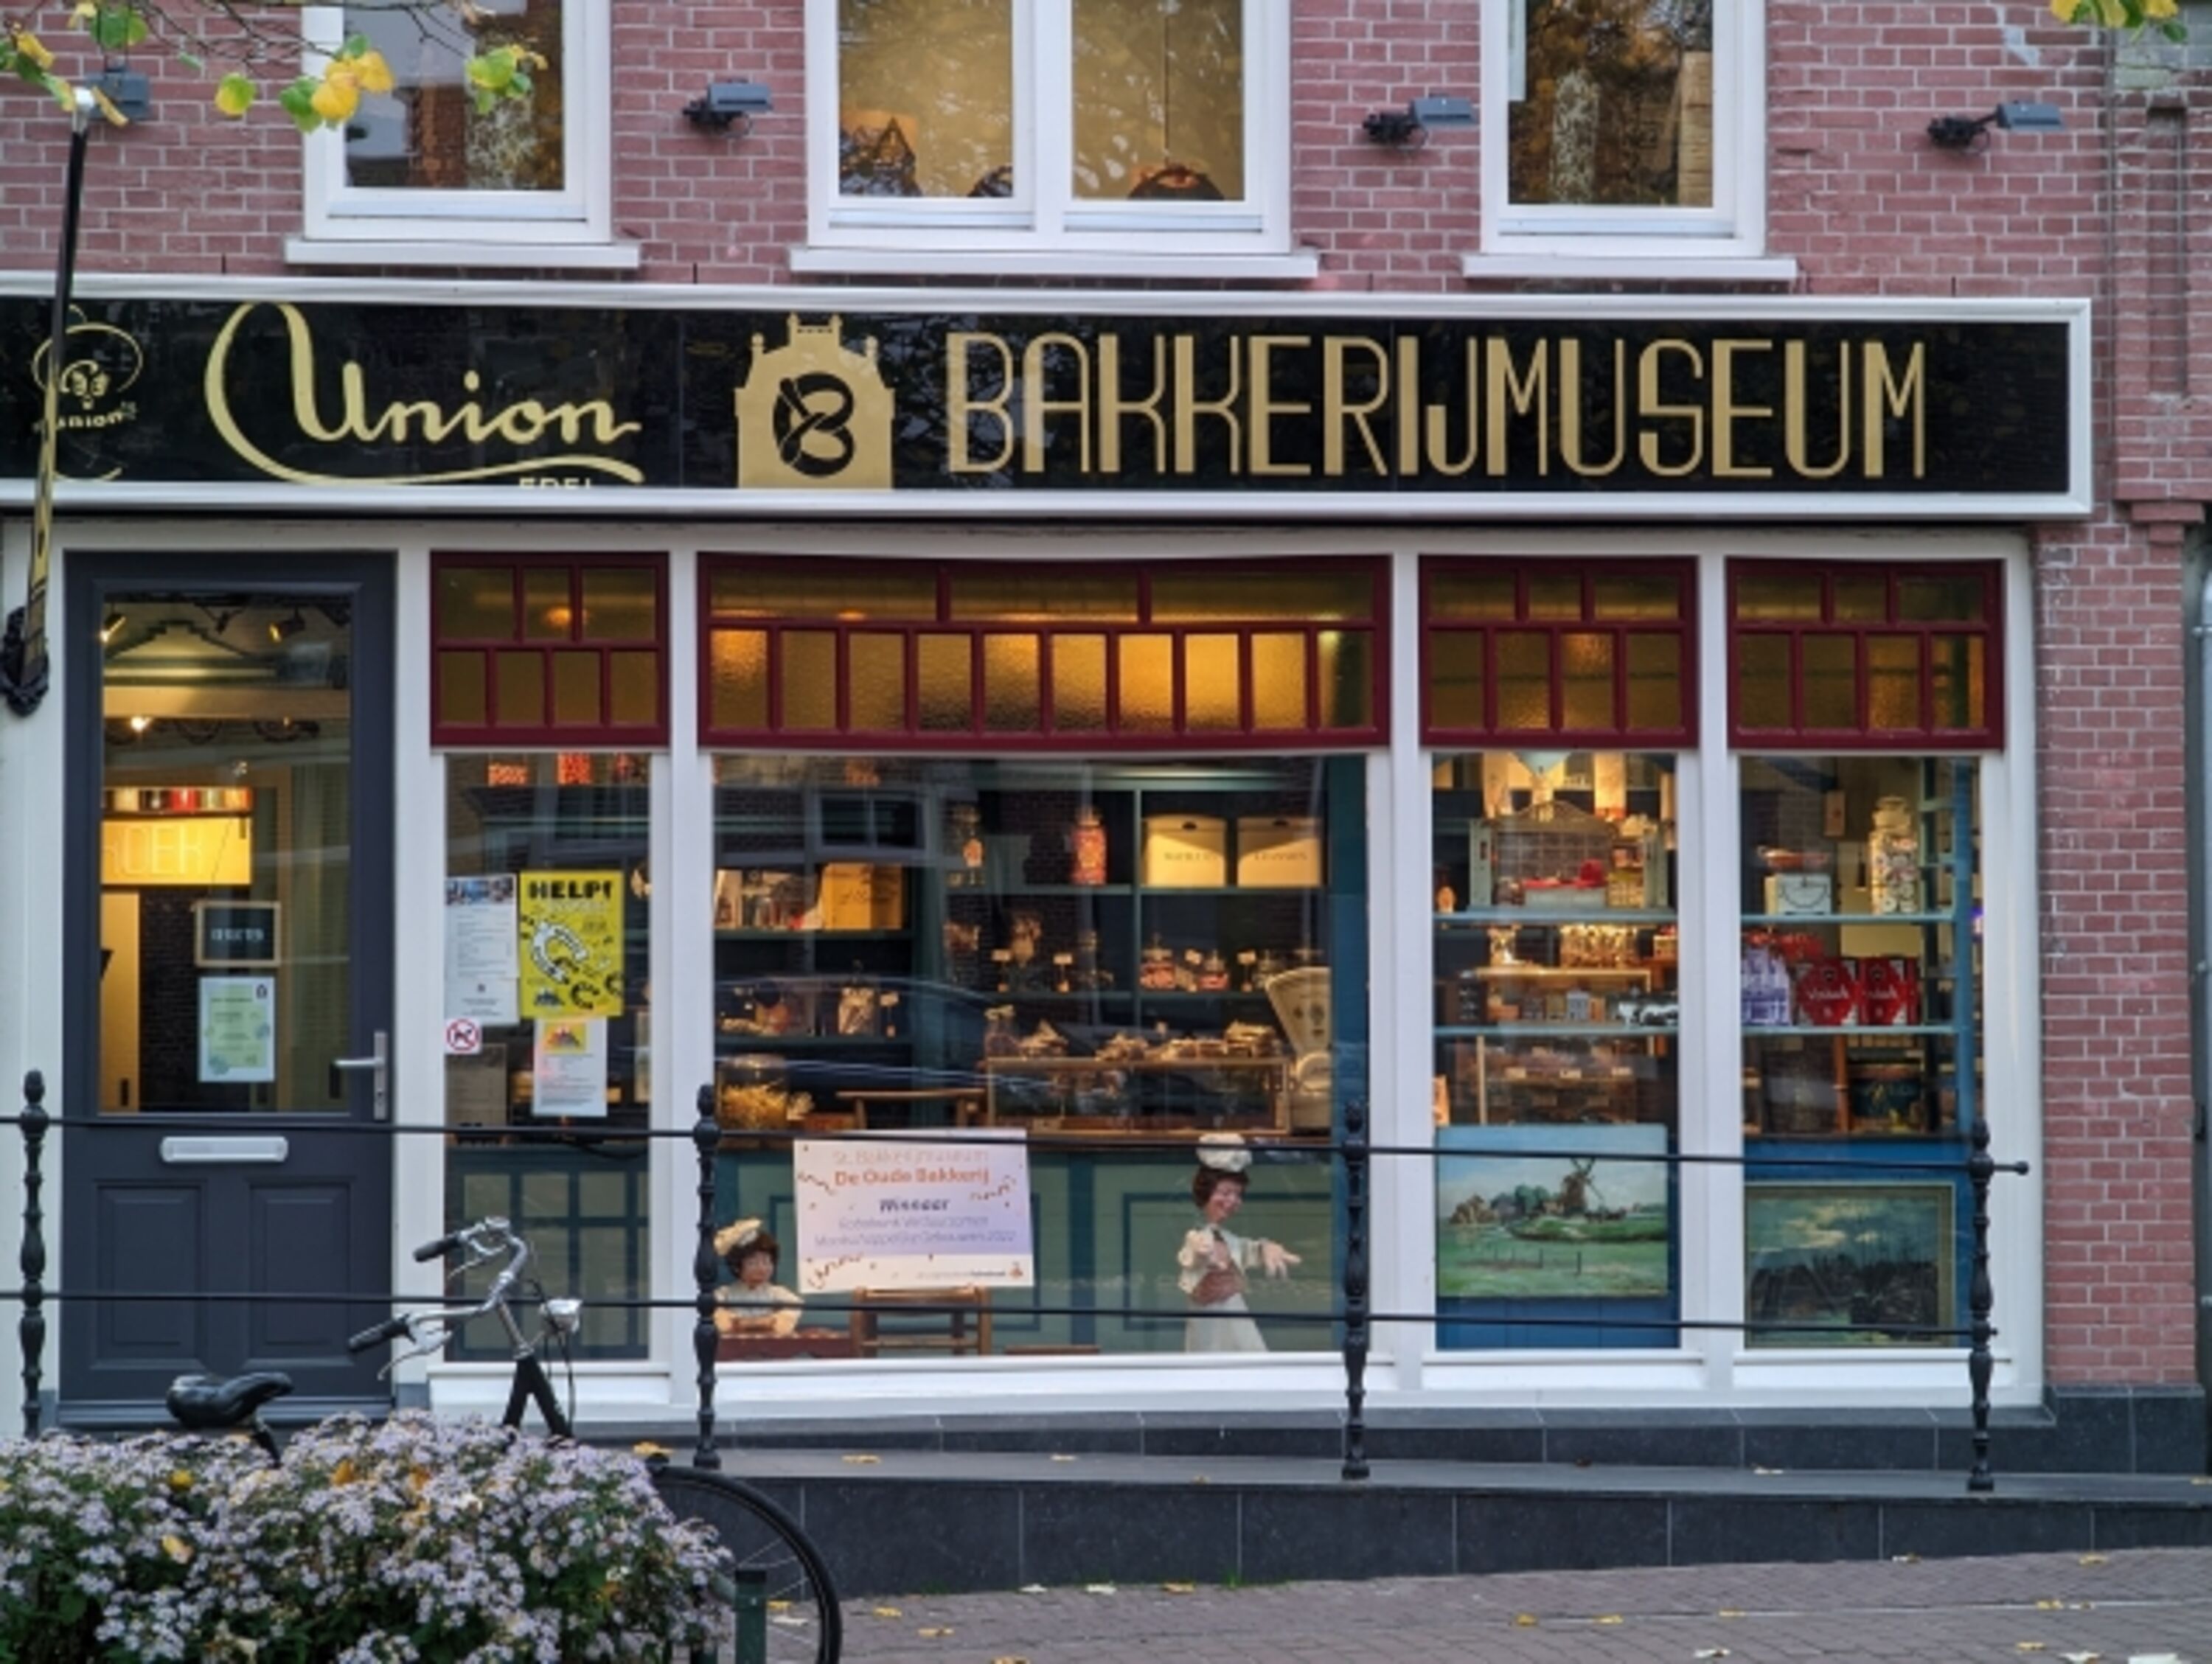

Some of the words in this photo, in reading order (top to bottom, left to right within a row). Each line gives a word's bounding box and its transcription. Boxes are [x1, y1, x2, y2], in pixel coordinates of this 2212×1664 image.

[204, 302, 642, 484] Union
[946, 332, 1925, 478] BAKKERIJMUSEUM
[835, 1171, 860, 1186] De
